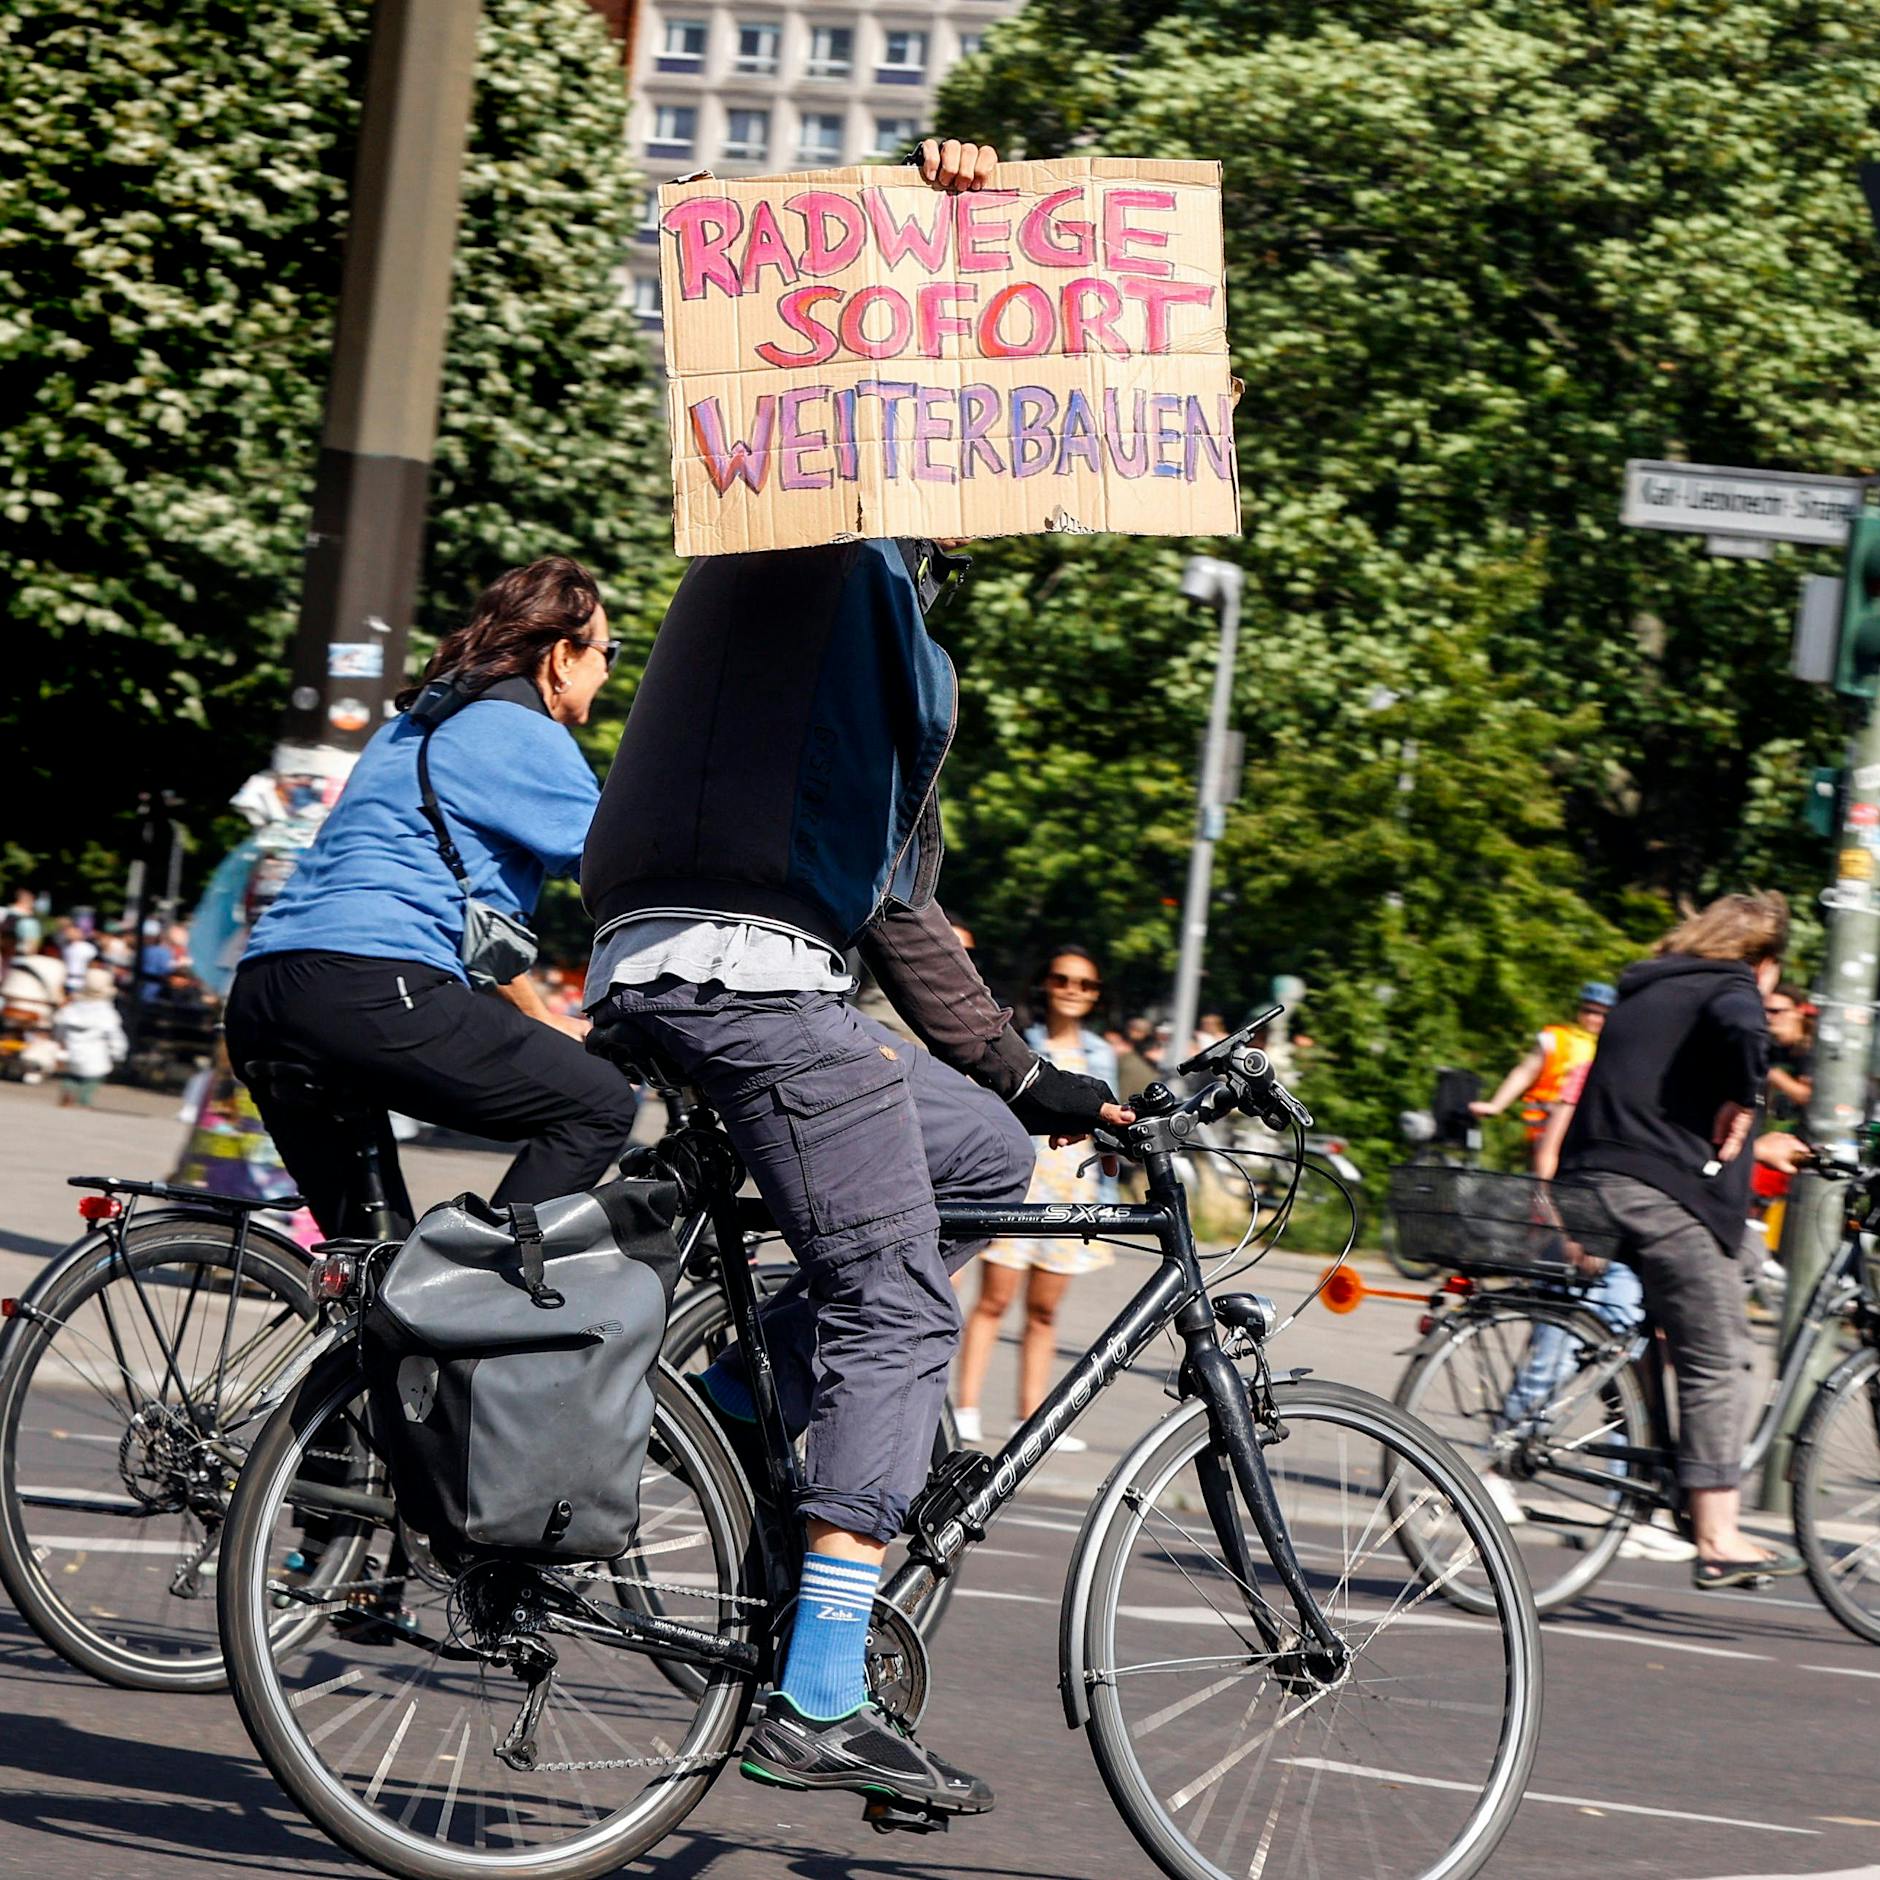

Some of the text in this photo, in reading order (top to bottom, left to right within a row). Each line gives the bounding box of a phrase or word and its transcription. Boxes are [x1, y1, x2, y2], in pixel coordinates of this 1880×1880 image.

[663, 187, 1178, 299] RADWEGE
[755, 276, 1215, 368] SOFORT
[690, 380, 1233, 498] WEITERBAUEN
